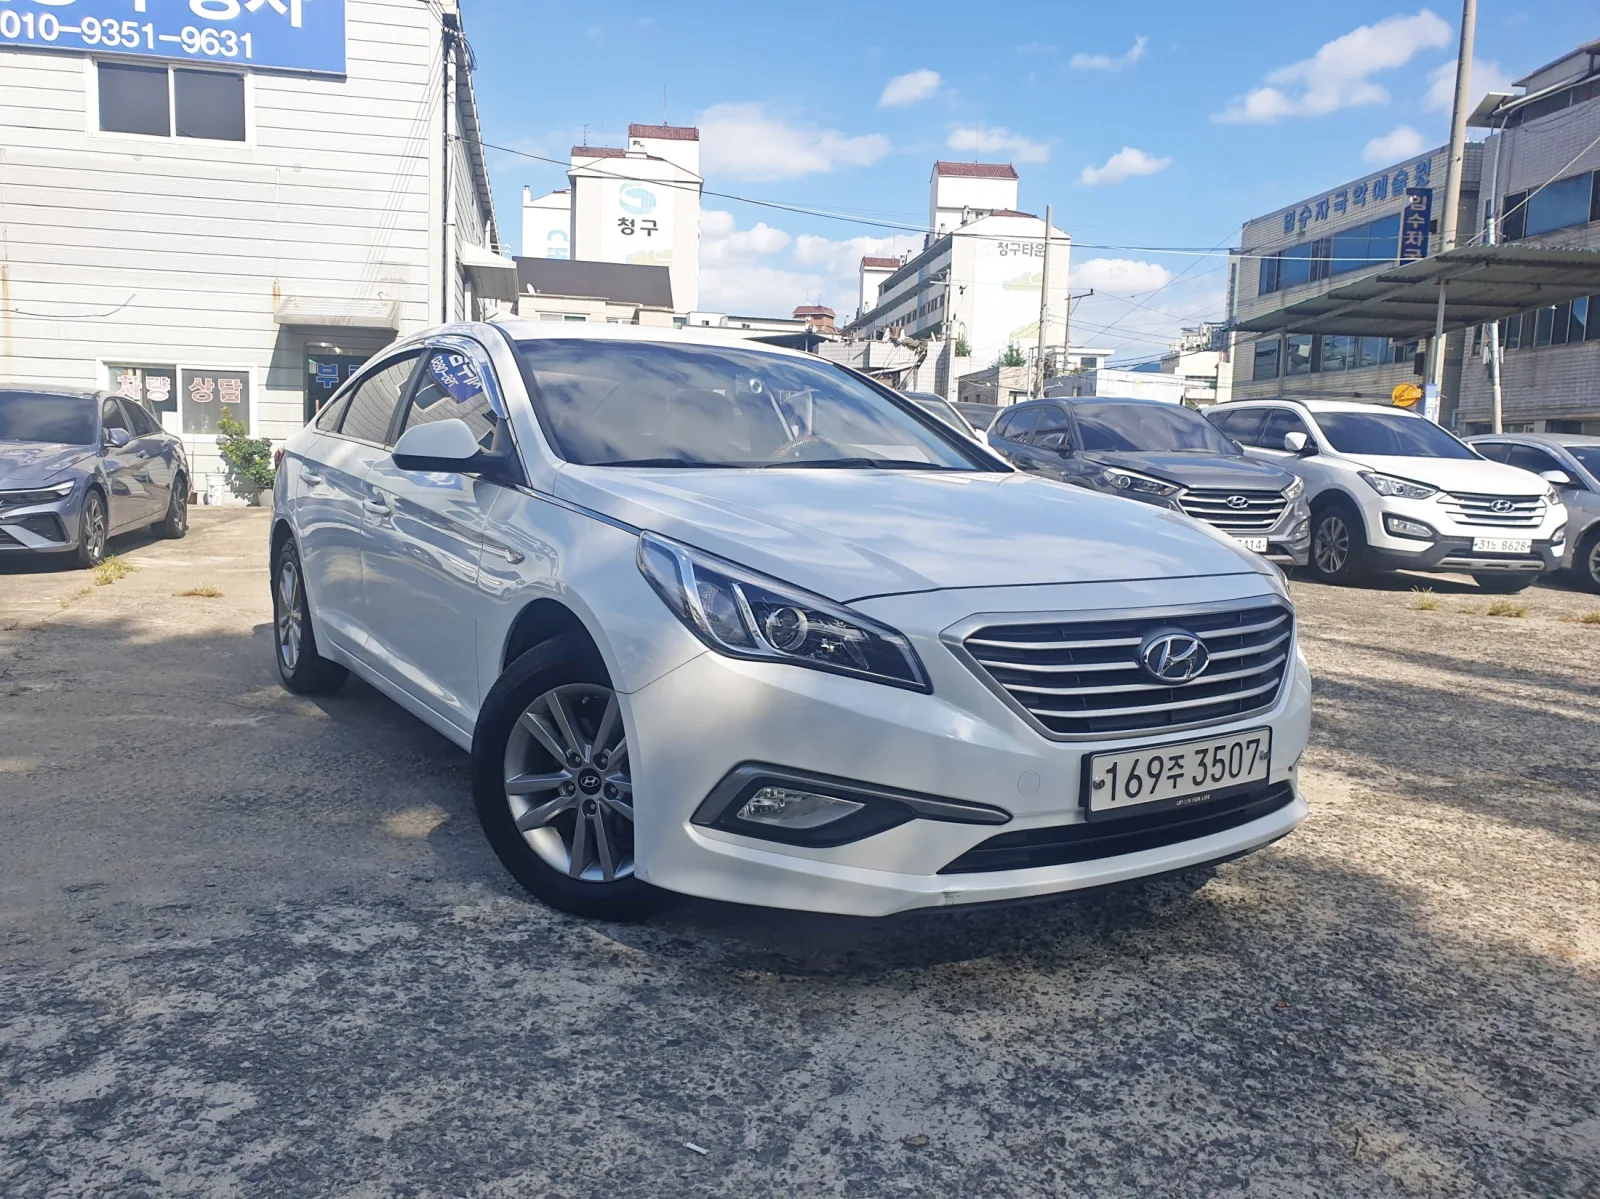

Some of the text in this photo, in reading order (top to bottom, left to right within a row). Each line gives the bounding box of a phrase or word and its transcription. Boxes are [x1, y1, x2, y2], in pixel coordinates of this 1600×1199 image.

[1, 11, 252, 58] 010-9351-9631
[617, 217, 659, 236] 청구
[997, 242, 1045, 257] 청구타운
[116, 376, 242, 403] 차량 상담
[1501, 540, 1527, 551] 8628
[1106, 738, 1261, 802] 169주 3507
